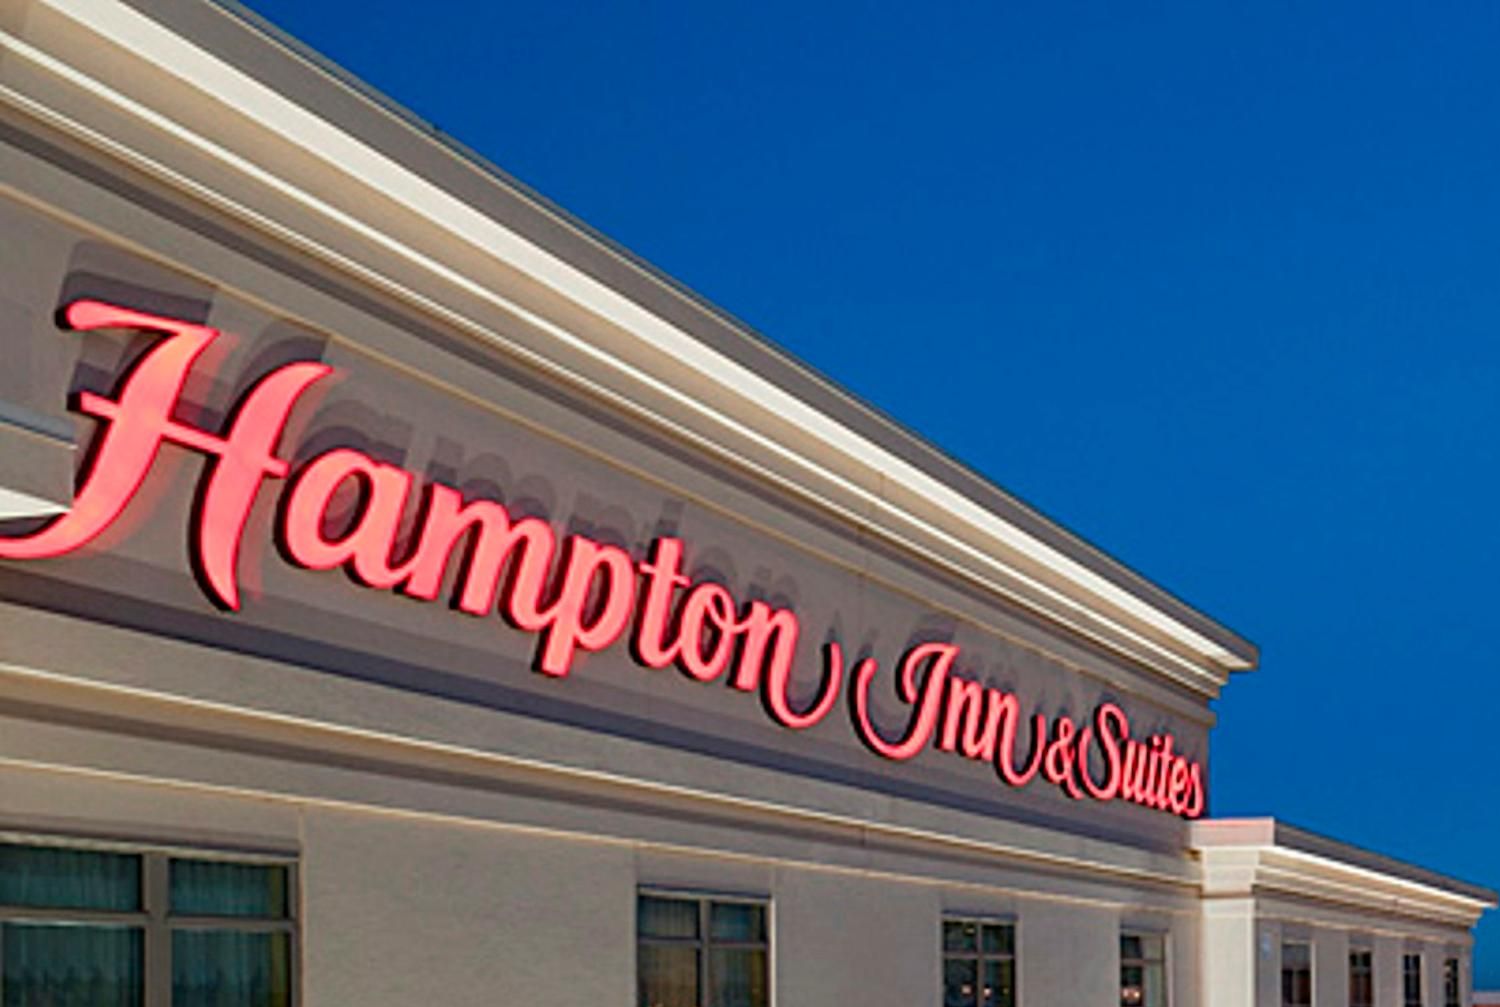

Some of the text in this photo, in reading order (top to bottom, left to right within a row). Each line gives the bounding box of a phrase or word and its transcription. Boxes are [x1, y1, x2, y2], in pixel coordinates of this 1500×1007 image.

[0, 300, 1204, 819] Hampton Inn & Suites
